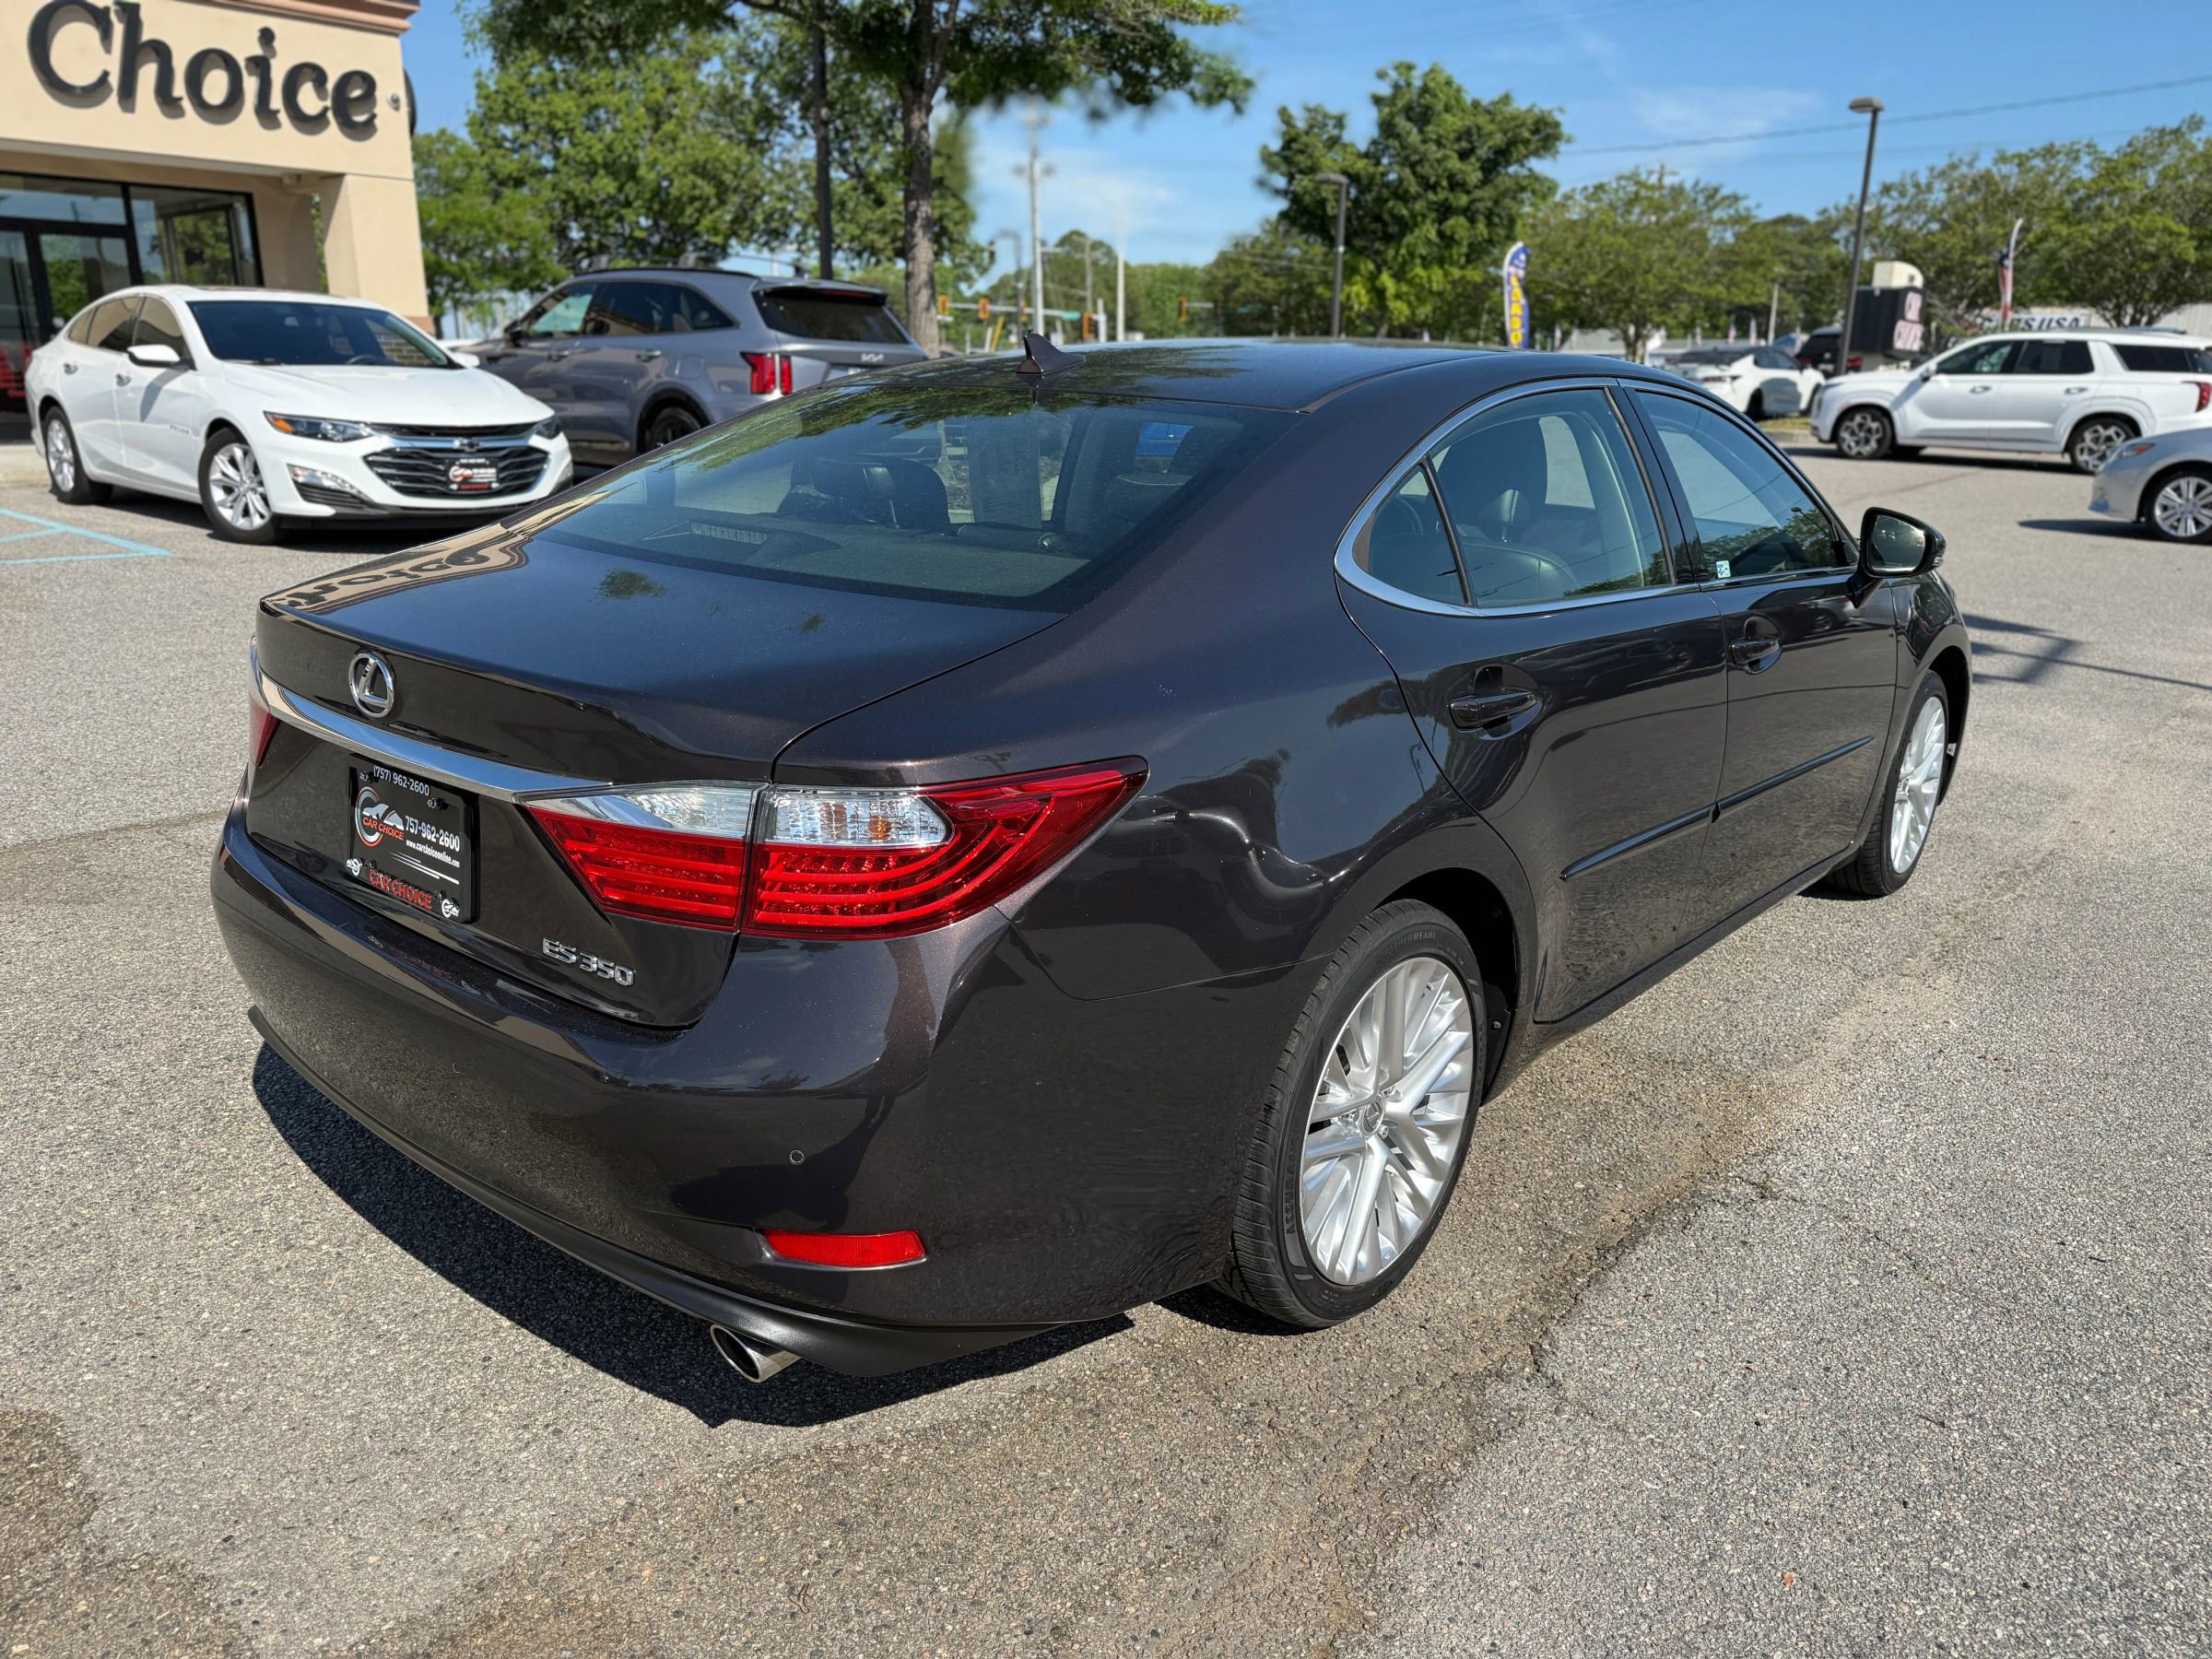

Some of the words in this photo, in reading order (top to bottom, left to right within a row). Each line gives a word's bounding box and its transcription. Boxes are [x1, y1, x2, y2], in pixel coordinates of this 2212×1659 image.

[28, 0, 377, 130] Choice
[373, 765, 392, 782] (757)
[393, 772, 429, 796] 962-2600
[362, 817, 378, 830] CAR
[378, 823, 406, 841] CHOICE
[405, 815, 460, 852] 757-962-2600
[406, 839, 460, 868] www.carchoiceonline.com
[370, 869, 390, 892] CAR
[392, 878, 433, 911] CHOICE
[542, 937, 577, 964] ES
[579, 952, 635, 986] 350
